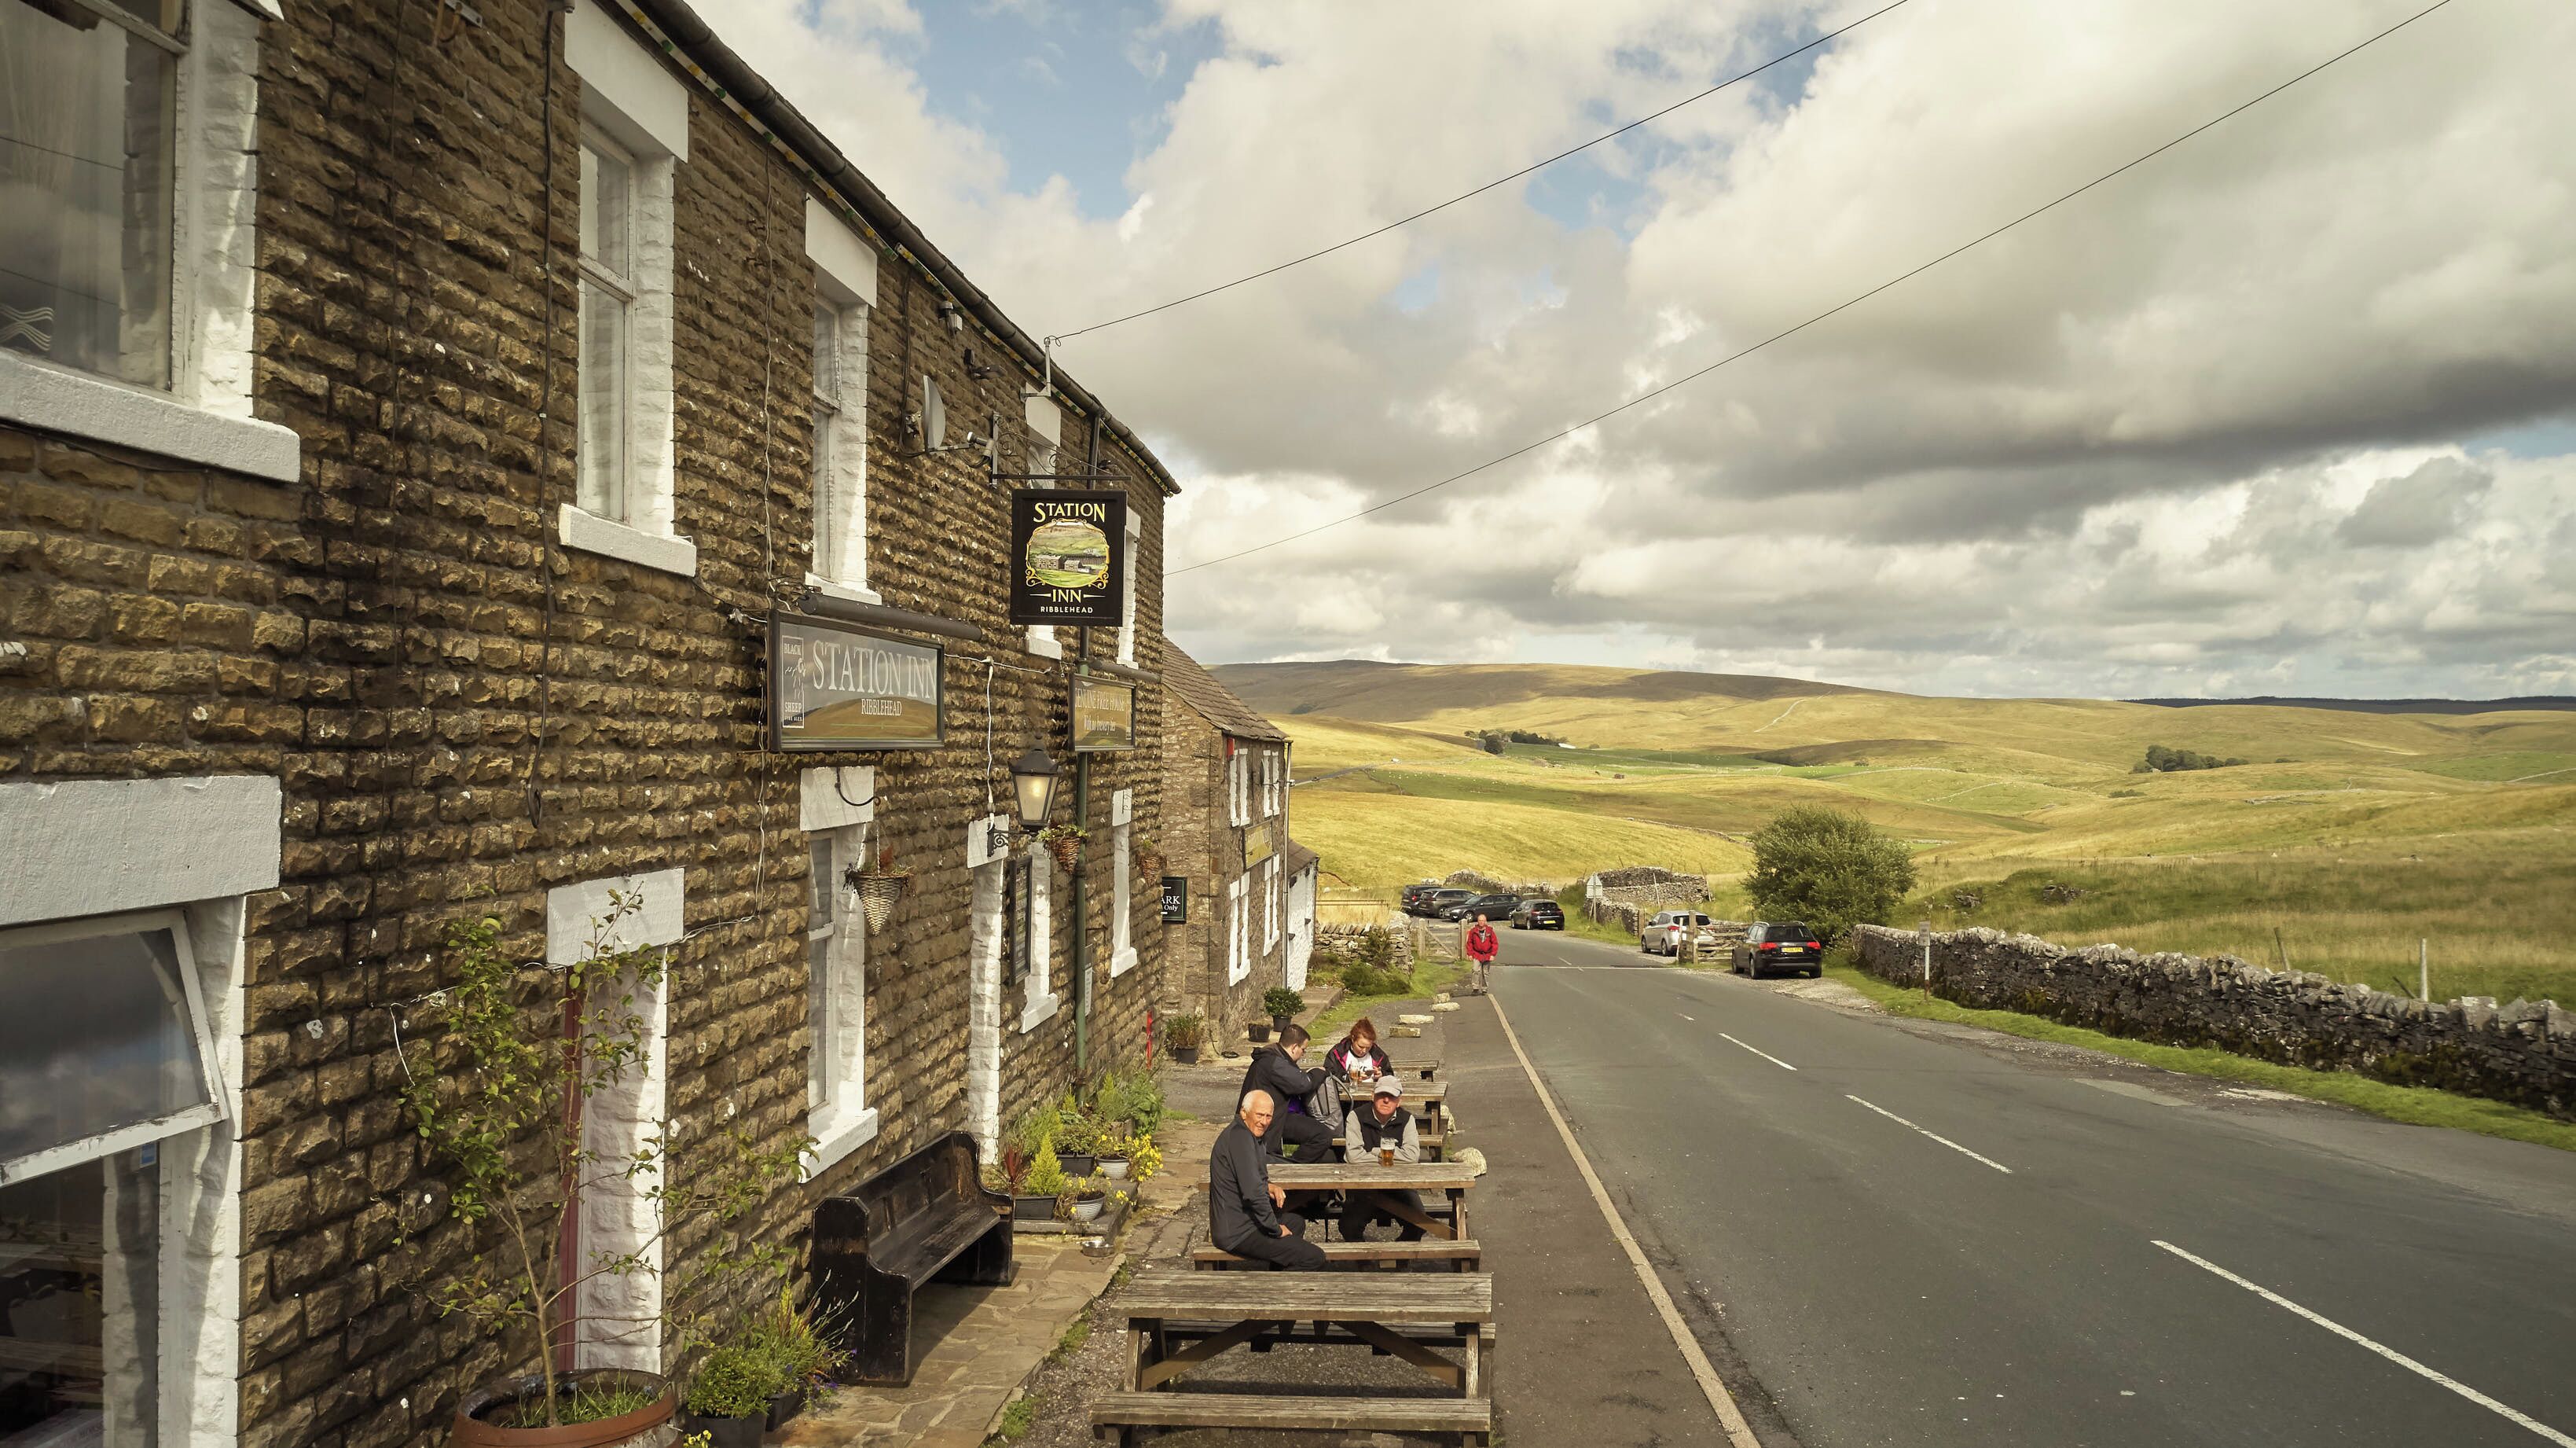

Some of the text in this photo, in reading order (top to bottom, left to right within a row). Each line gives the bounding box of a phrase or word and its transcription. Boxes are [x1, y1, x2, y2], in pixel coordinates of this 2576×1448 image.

[1033, 502, 1105, 523] STATION
[1051, 590, 1081, 603] INN
[784, 643, 802, 656] BLACK
[813, 640, 937, 699] STATION INN
[785, 702, 802, 713] SHEEP
[861, 698, 902, 716] RIBBLEHEAD
[1097, 691, 1109, 710] FREE
[1161, 895, 1180, 904] ARK
